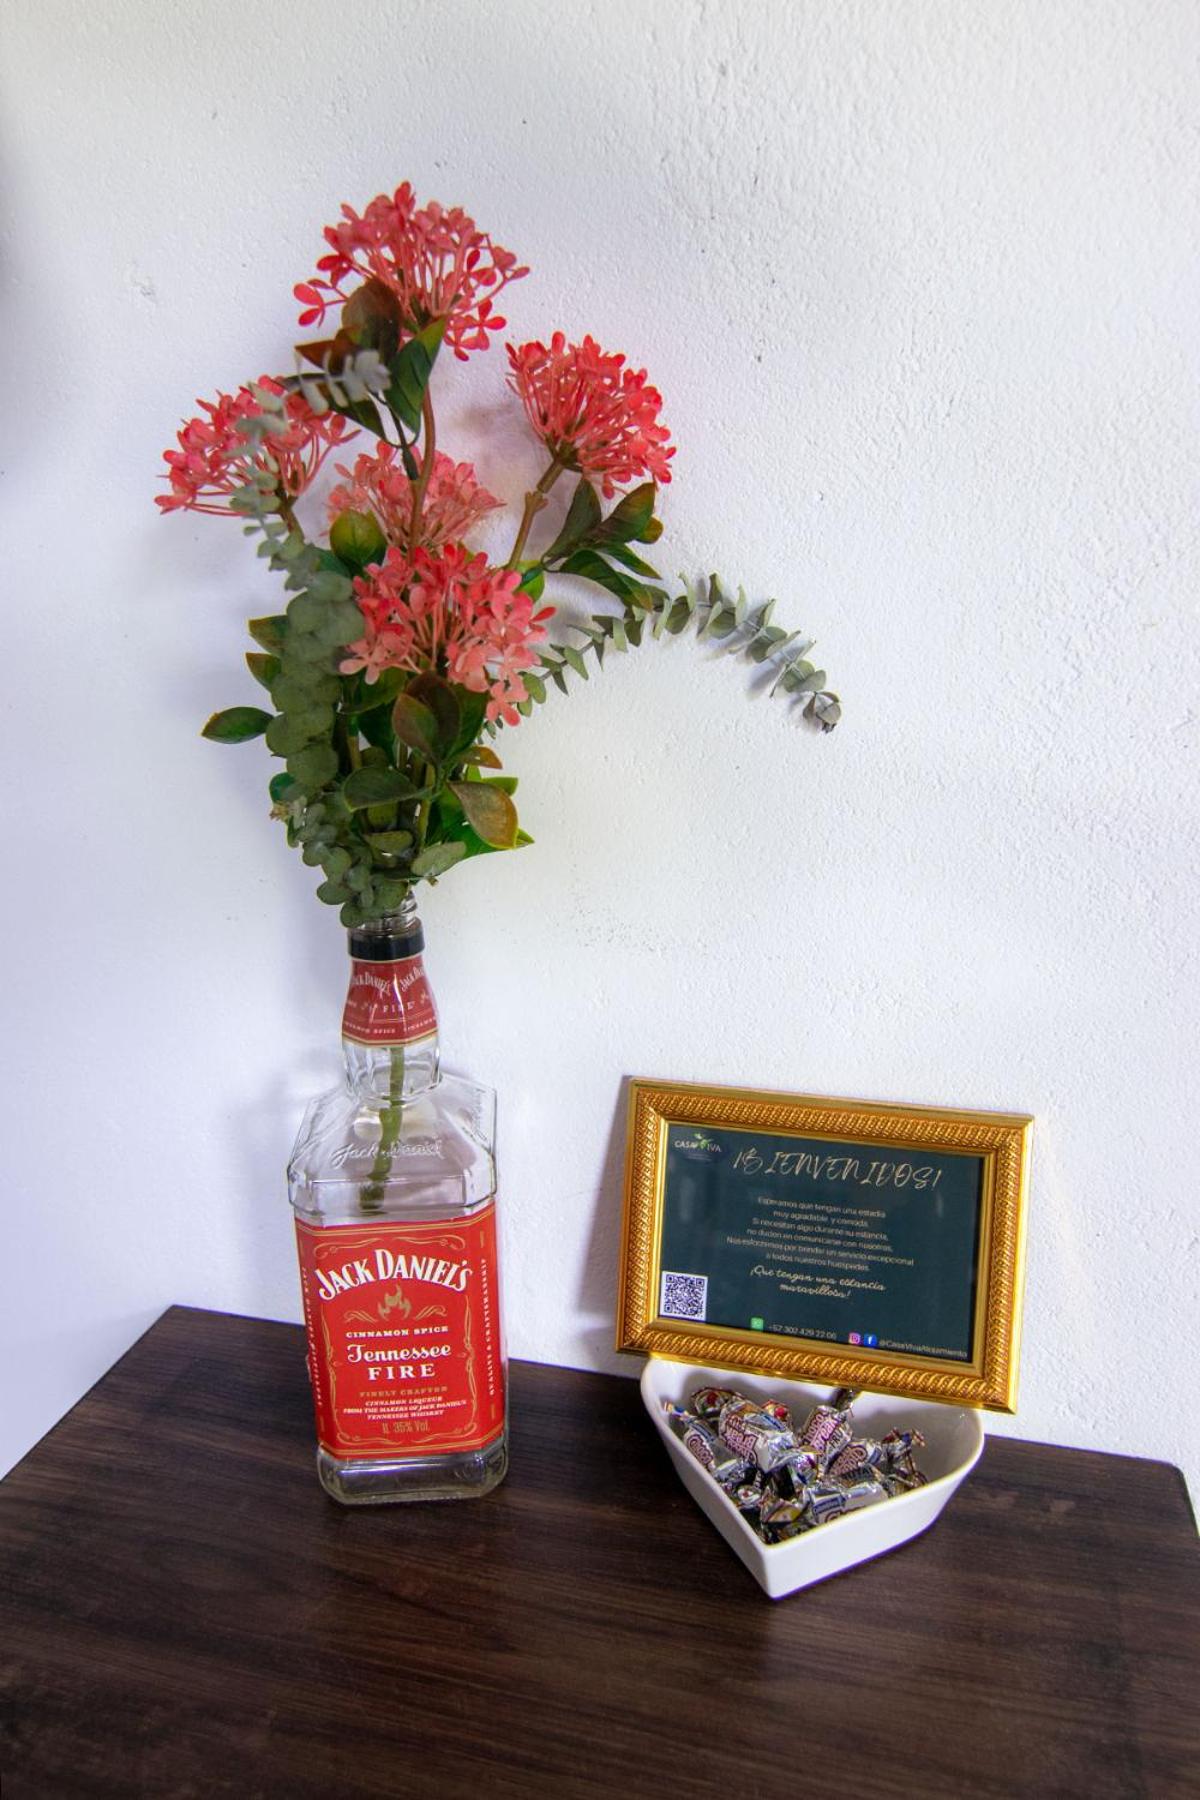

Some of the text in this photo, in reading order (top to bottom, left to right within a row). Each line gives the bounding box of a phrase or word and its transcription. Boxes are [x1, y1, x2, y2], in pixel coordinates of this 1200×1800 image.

[758, 1197, 798, 1208] Esperamos
[815, 1204, 841, 1214] tengan
[773, 1211, 789, 1219] muy
[791, 1212, 828, 1223] agradable
[760, 1219, 795, 1229] necesitan
[797, 1223, 813, 1232] algo
[815, 1225, 843, 1235] durante
[772, 1253, 793, 1262] todos
[794, 1256, 826, 1266] nuestros
[314, 1249, 472, 1300] JACK DANIEL'S
[776, 1270, 812, 1283] tengan
[816, 1276, 836, 1284] una
[346, 1325, 449, 1338] CINNAMON SPICE
[347, 1343, 452, 1363] Tennessee
[368, 1363, 436, 1381] FIRE
[408, 1396, 443, 1405] LIQUEUR
[367, 1409, 445, 1421] TENNESSEE WHISKEY
[379, 1405, 408, 1413] MAKERS
